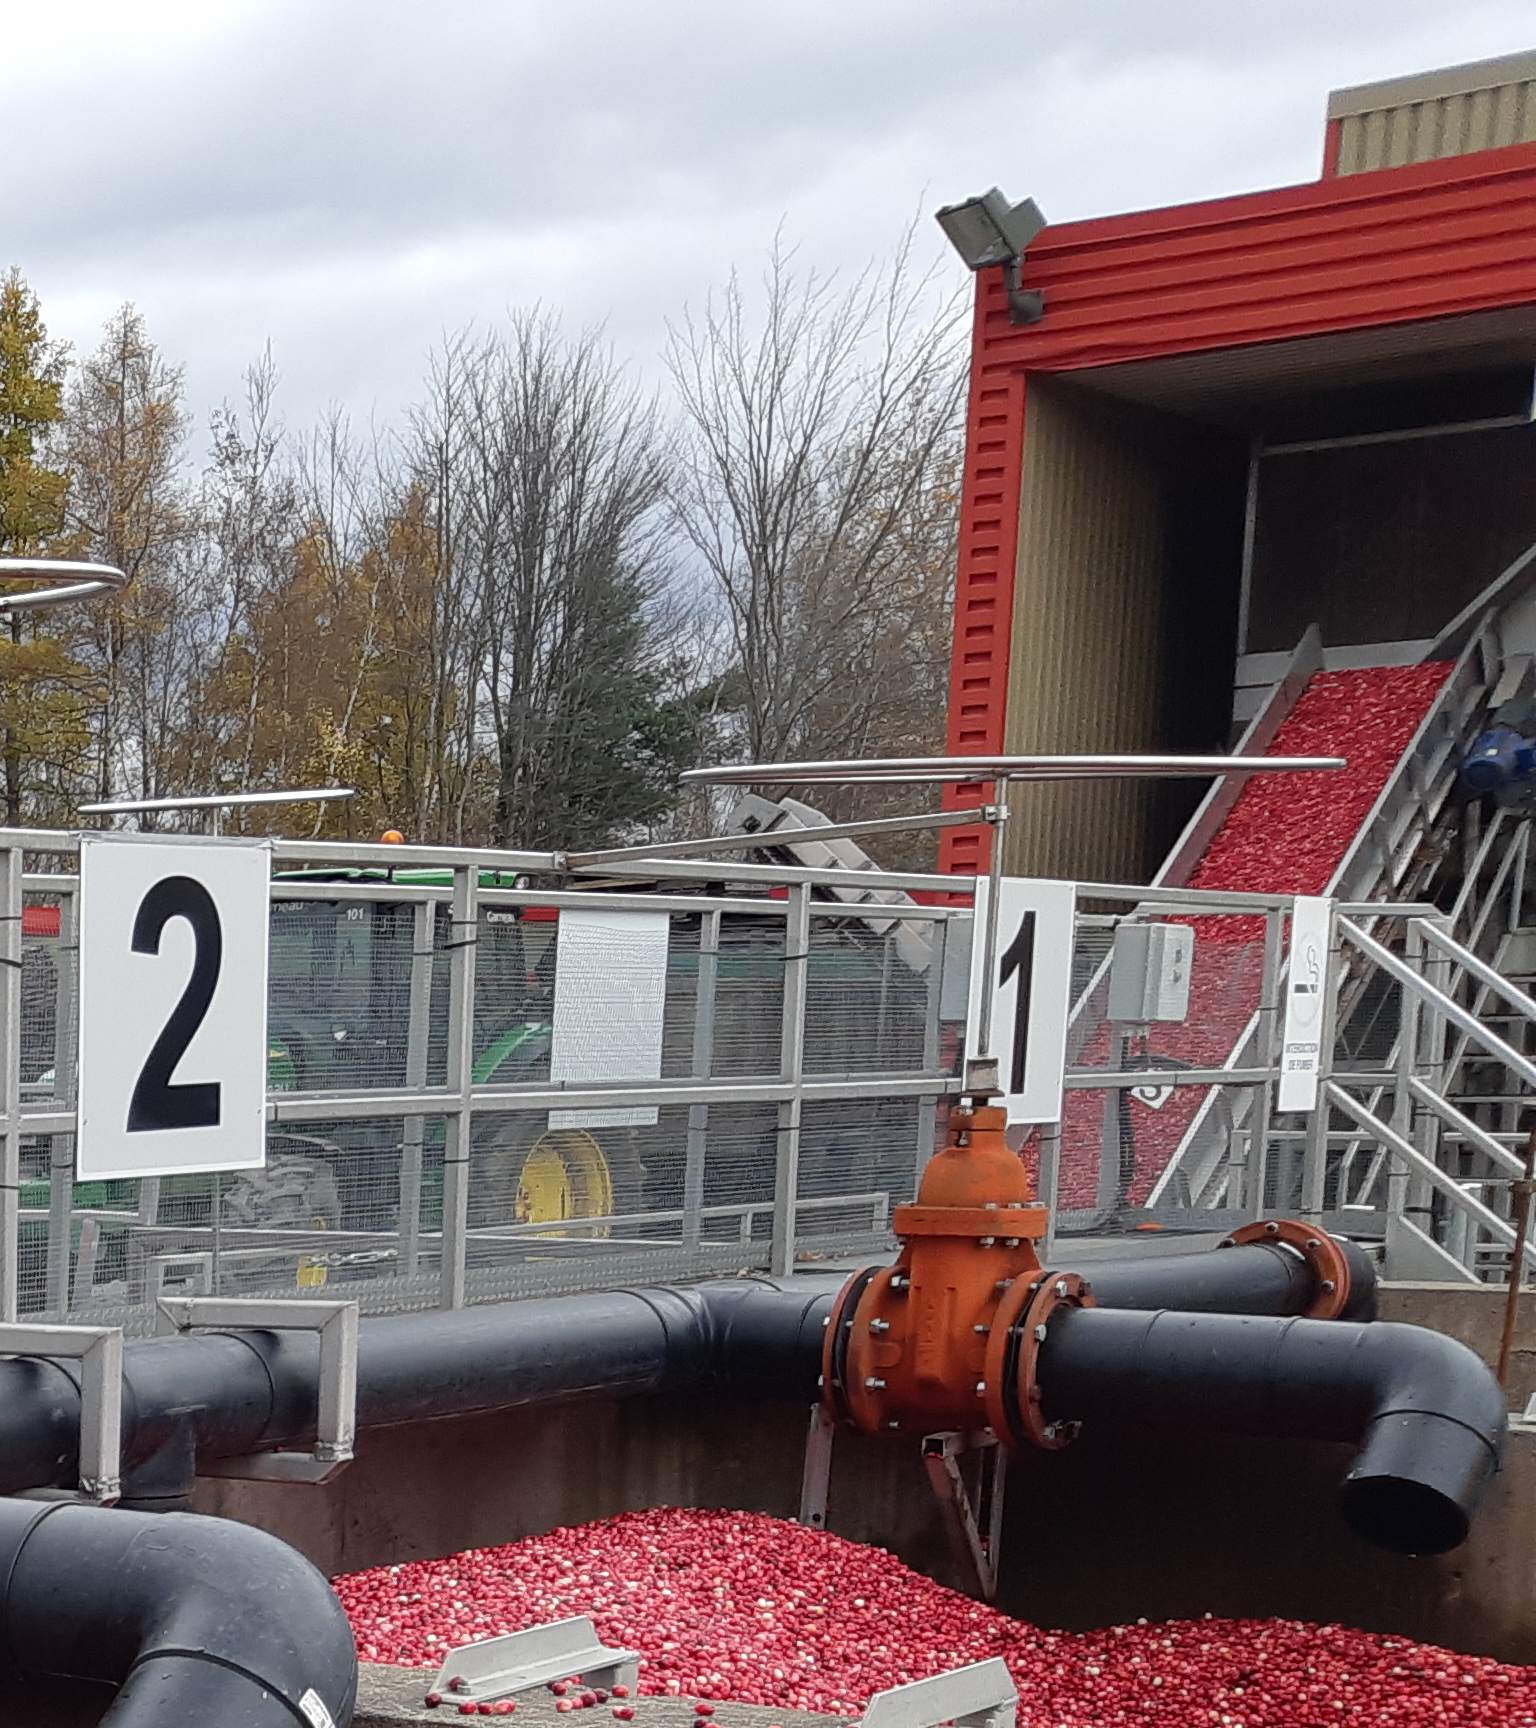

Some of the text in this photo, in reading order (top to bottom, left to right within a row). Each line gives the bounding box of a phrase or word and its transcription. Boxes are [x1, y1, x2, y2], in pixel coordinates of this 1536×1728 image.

[127, 876, 222, 1132] 2
[346, 907, 364, 921] 101
[1000, 911, 1035, 1094] 1
